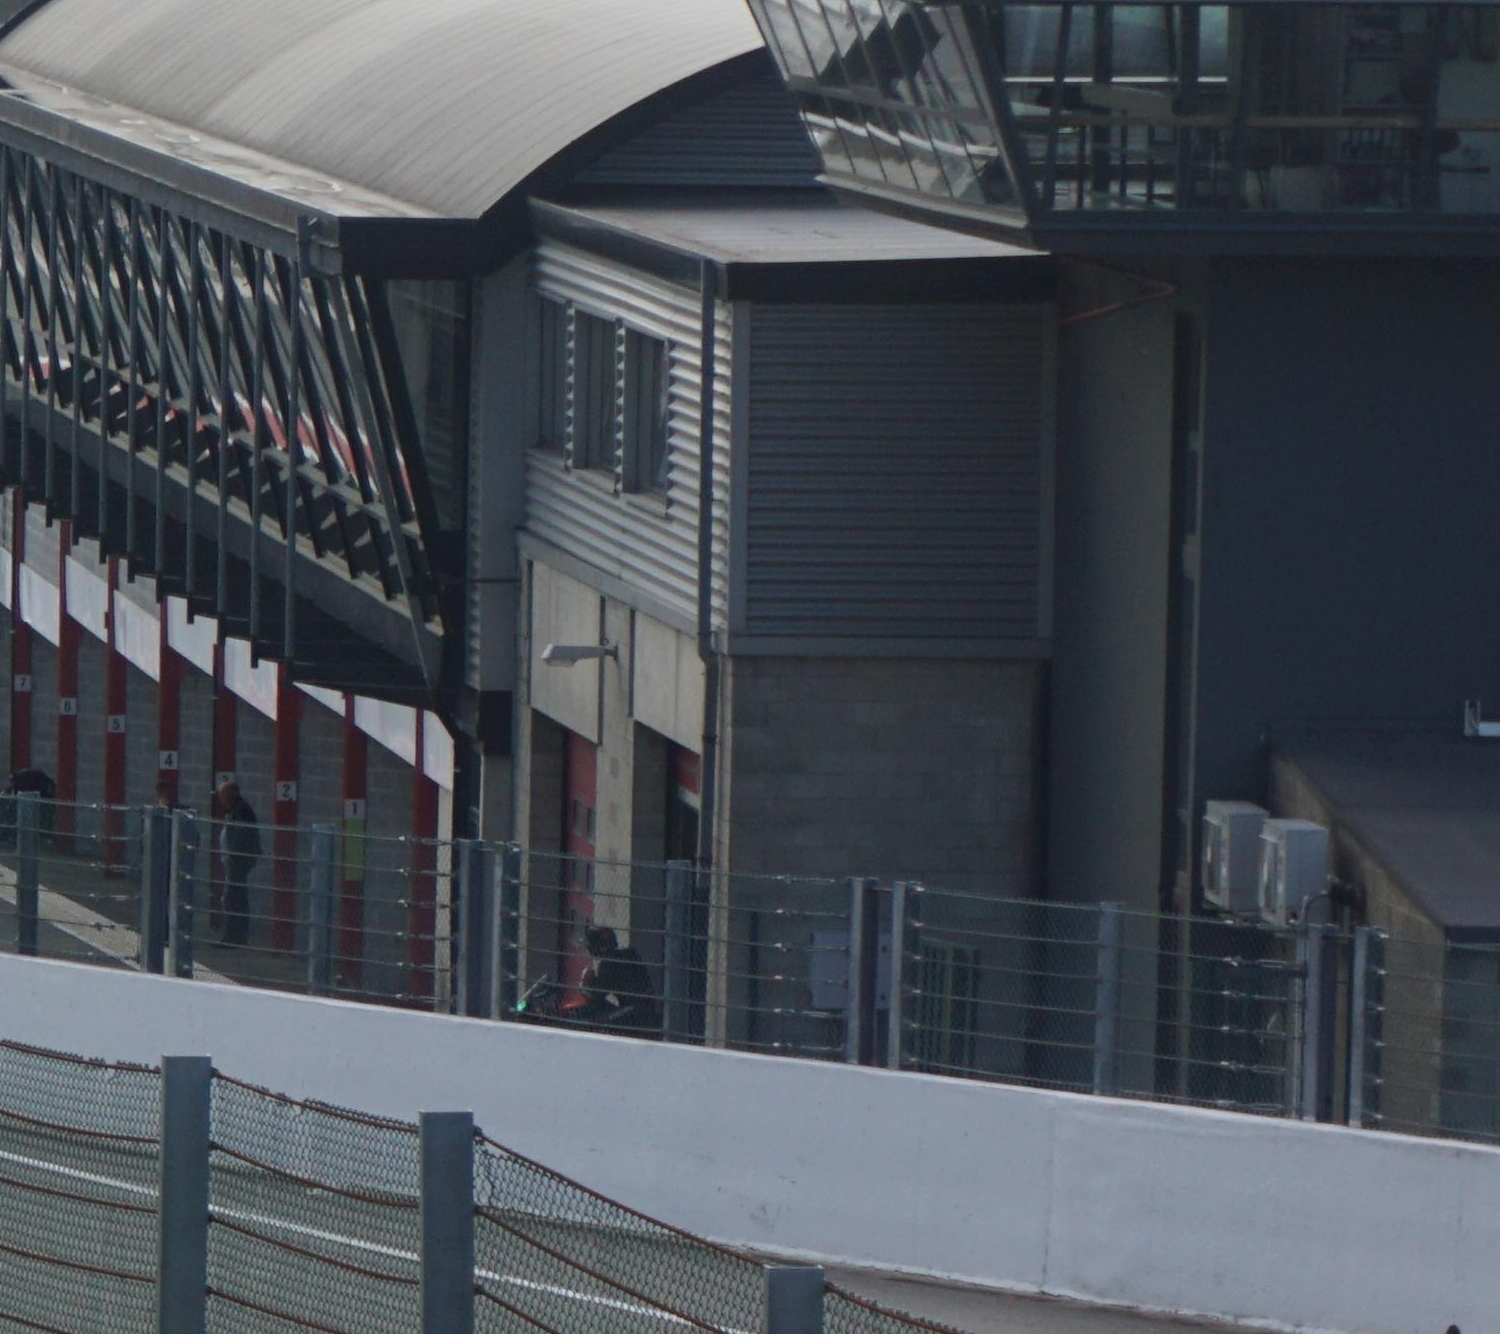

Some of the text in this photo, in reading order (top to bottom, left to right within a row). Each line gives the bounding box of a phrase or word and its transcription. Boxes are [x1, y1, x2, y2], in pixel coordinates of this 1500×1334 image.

[113, 718, 120, 730] 5
[164, 754, 173, 767] 4
[282, 784, 292, 799] 2
